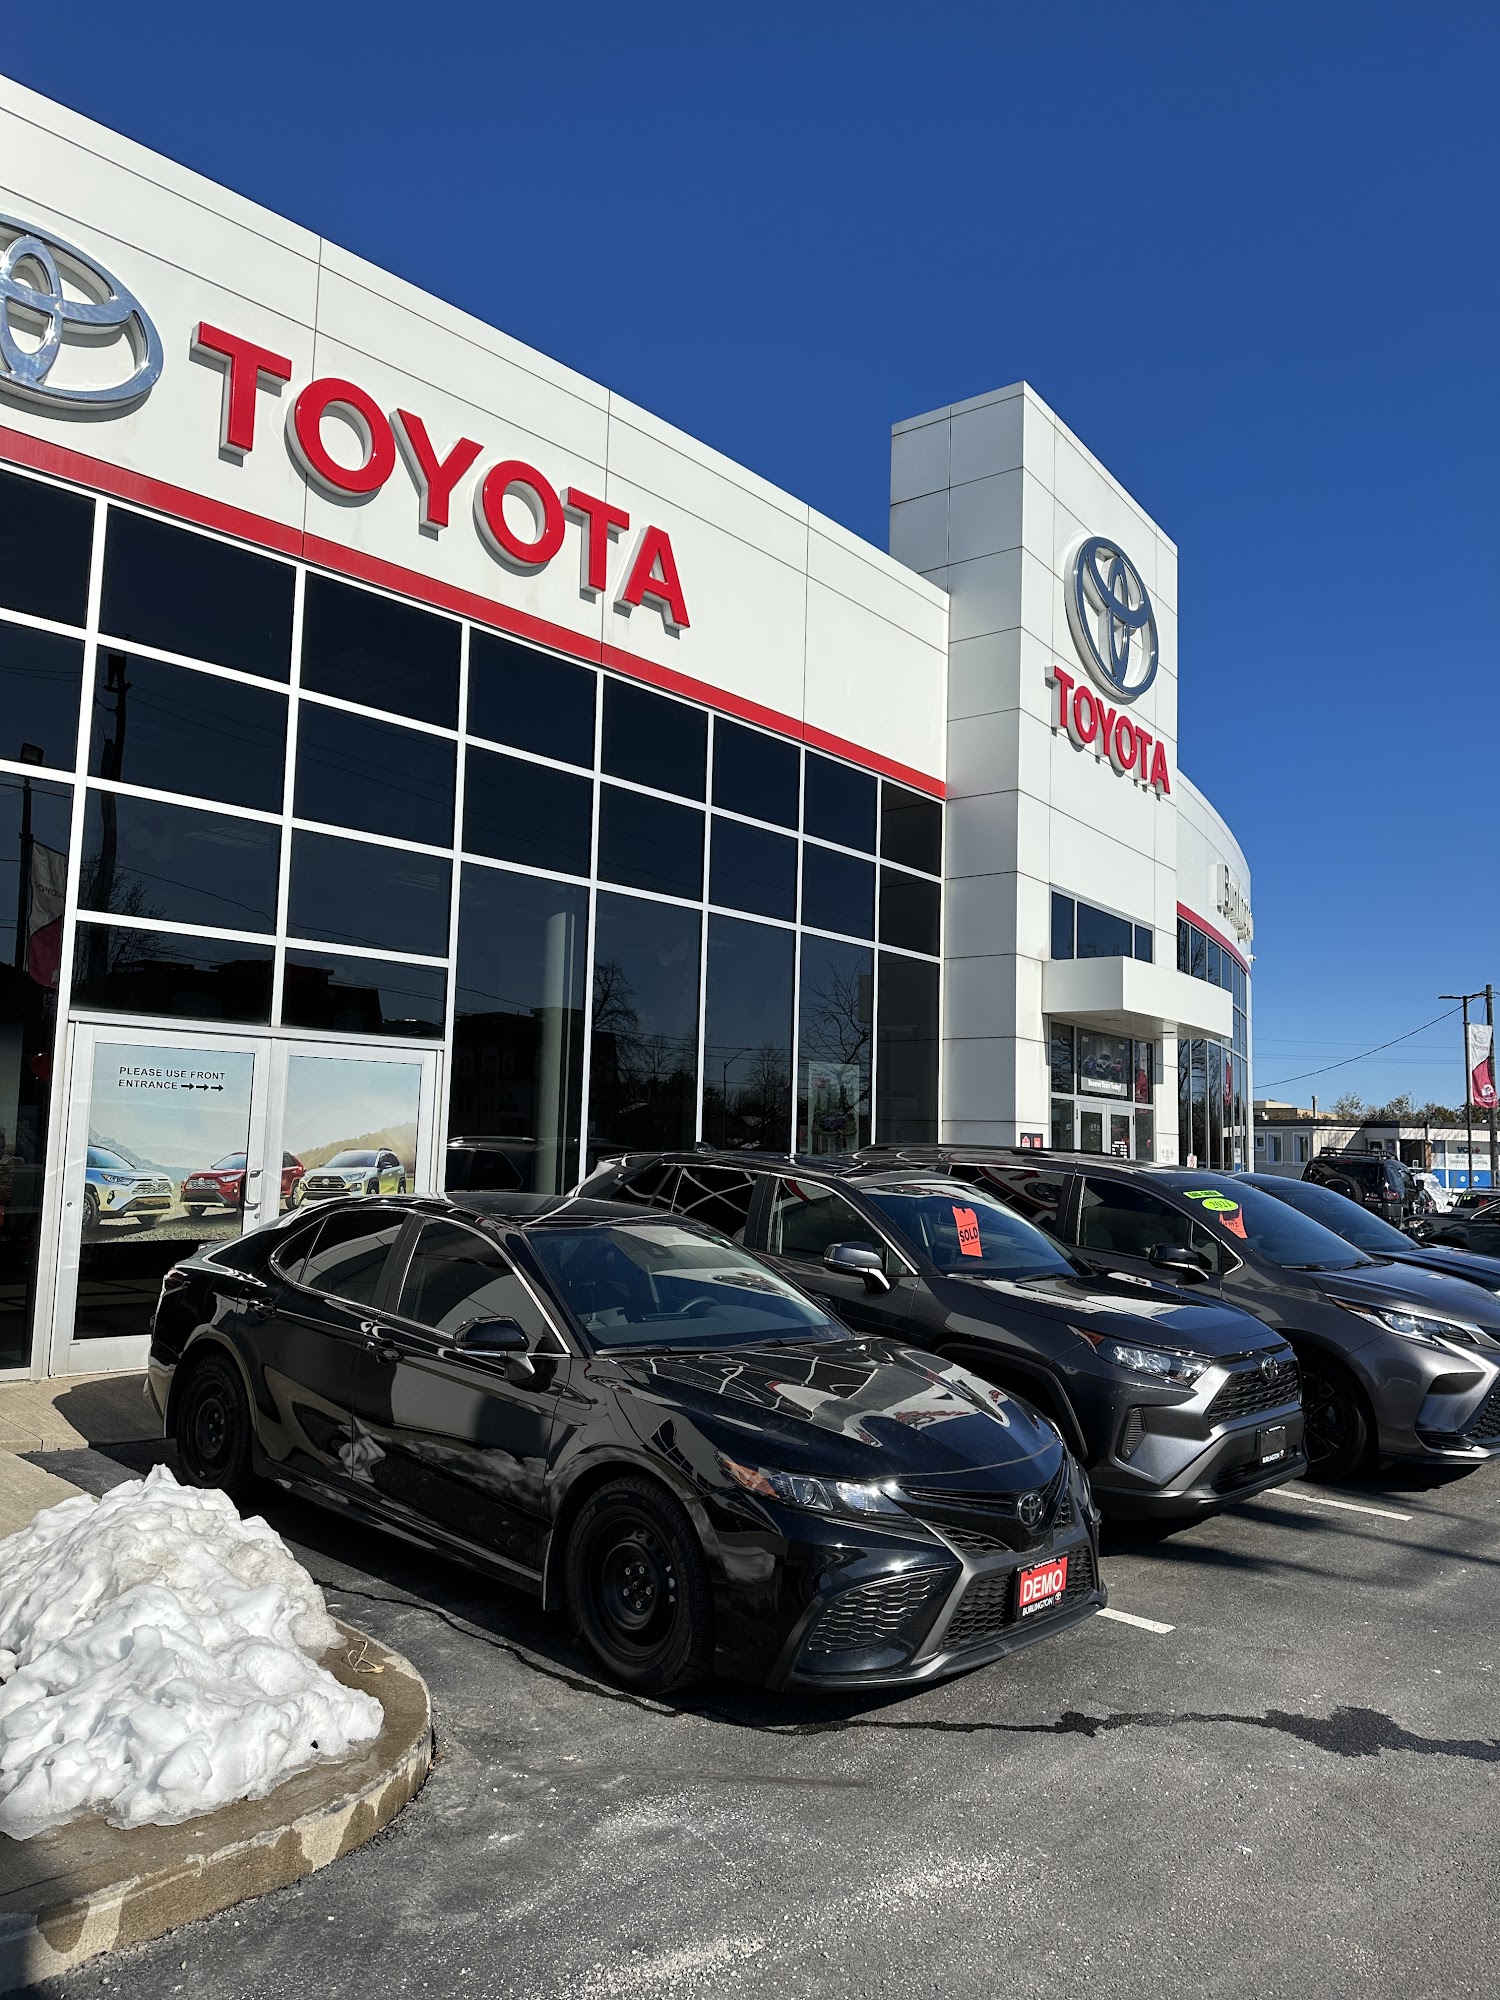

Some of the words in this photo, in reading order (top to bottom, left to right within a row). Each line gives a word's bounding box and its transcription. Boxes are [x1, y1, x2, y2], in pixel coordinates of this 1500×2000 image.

[193, 321, 691, 632] TOYOTA
[1049, 665, 1172, 796] TOYOTA
[119, 1066, 163, 1077] PLEASE
[166, 1069, 187, 1078] USE
[190, 1071, 226, 1080] FRONT
[118, 1079, 178, 1090] ENTRANCE
[1209, 1200, 1232, 1209] 2021
[959, 1227, 978, 1243] SOLD
[1023, 1569, 1063, 1603] DEMO
[1022, 1597, 1053, 1616] BURLINGTON
